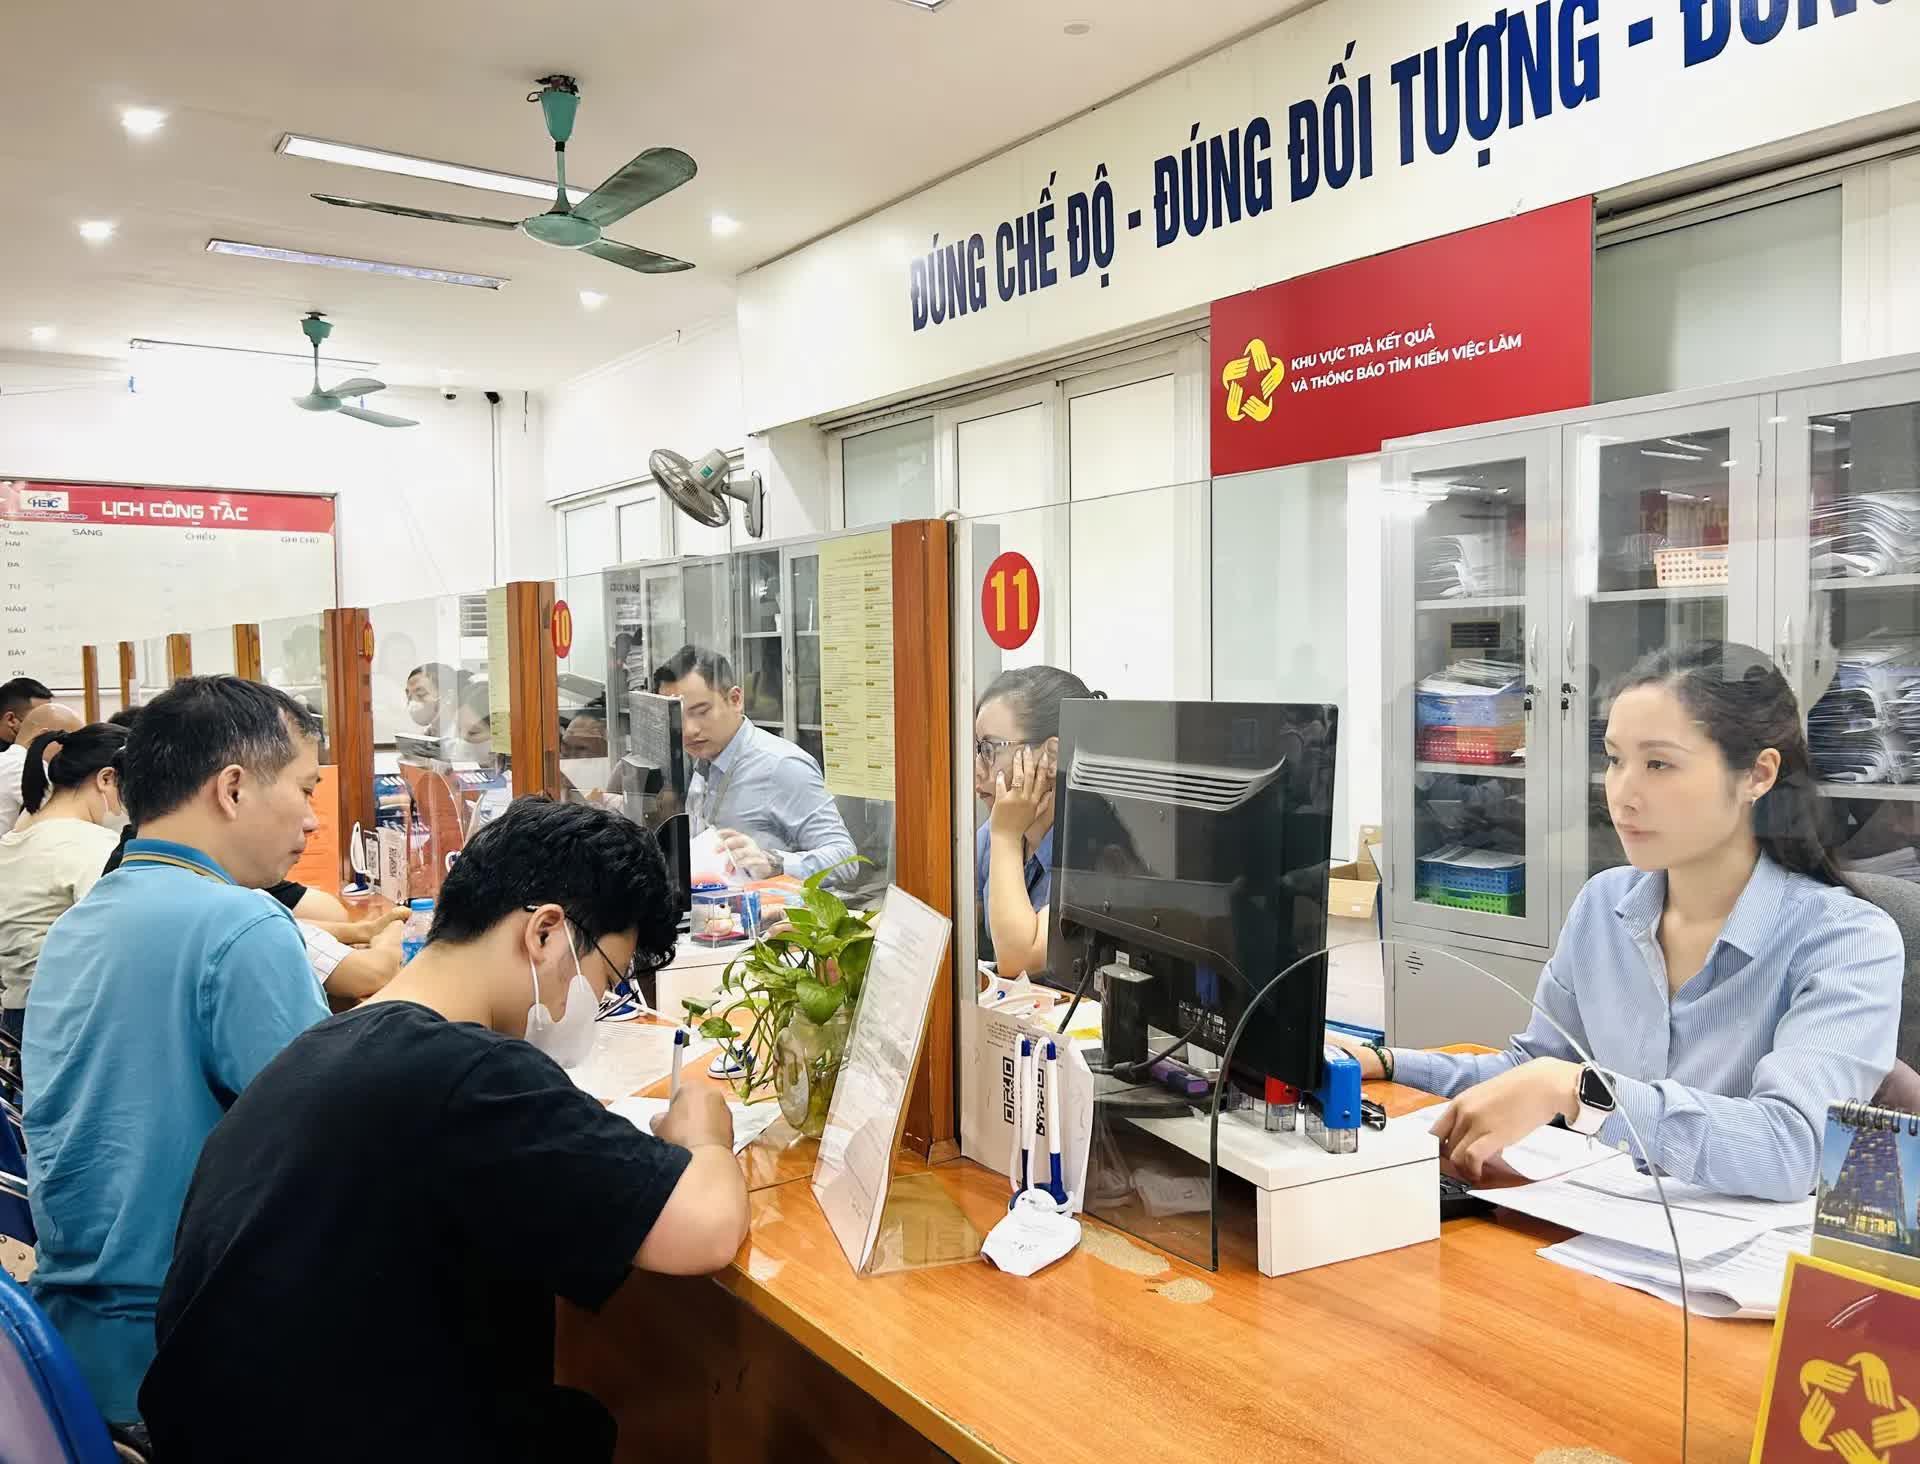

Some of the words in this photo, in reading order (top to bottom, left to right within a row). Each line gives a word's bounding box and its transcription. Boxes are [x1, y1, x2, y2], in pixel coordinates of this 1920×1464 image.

[909, 232, 987, 332] ĐÚNG
[995, 170, 1058, 302] CHẾ
[1066, 162, 1116, 288] ĐỘ
[1153, 116, 1273, 249] ĐÚNG
[1287, 40, 1373, 203] ĐỐI
[1390, 0, 1600, 168] TƯỢNG
[1291, 352, 1317, 371] KHU
[1319, 346, 1346, 365] VỰC
[1348, 336, 1374, 359] TRẢ
[1376, 330, 1402, 352] KẾT
[1403, 322, 1435, 348] QUẢ
[1291, 374, 1309, 393] VÀ
[1310, 368, 1354, 391] THÔNG
[1356, 361, 1386, 382] BÁO
[1387, 355, 1412, 374] TÌM
[1414, 346, 1449, 371] KIẾM
[1451, 340, 1486, 361] VIỆC
[1488, 332, 1523, 353] LÀM
[101, 500, 144, 519] LỊCH
[149, 500, 204, 519] CÔNG
[990, 567, 1028, 632] 11
[553, 608, 571, 648] 10
